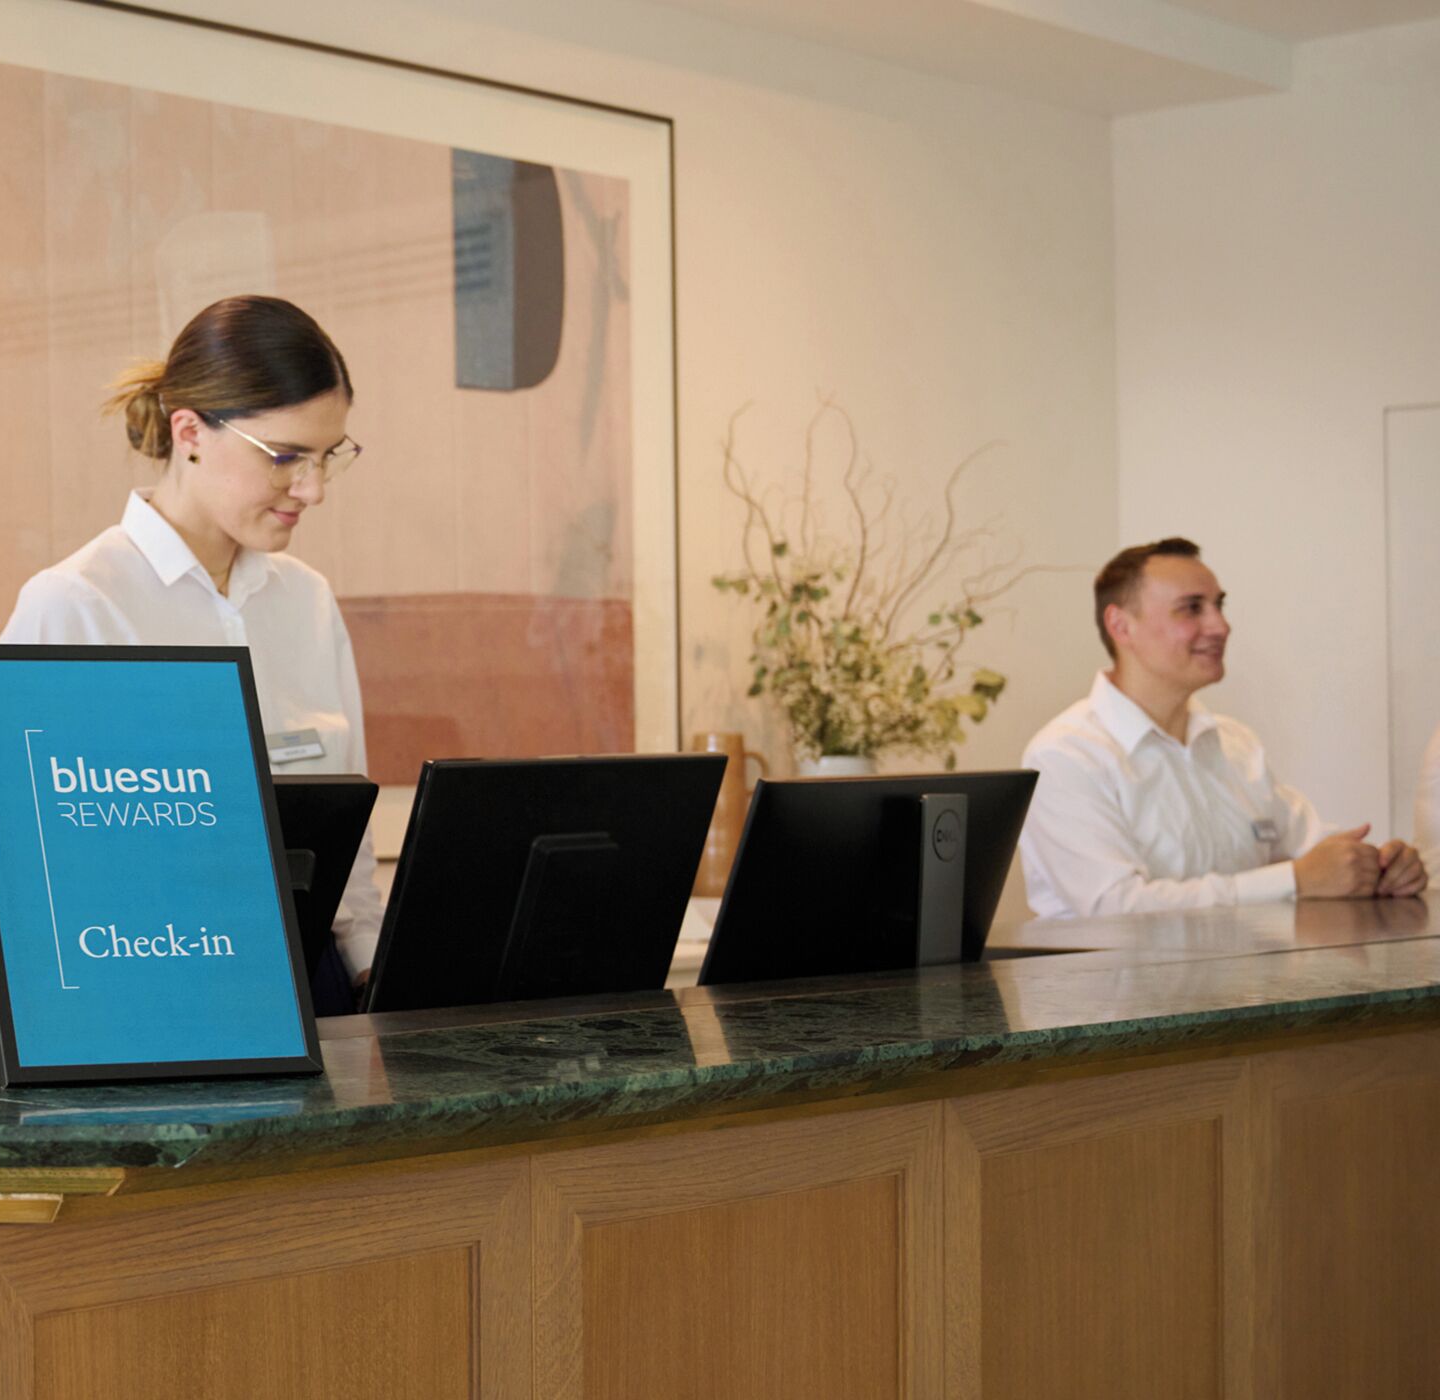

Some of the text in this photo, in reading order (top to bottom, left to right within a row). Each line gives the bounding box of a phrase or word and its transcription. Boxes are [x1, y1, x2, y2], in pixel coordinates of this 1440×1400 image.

[50, 756, 212, 793] bluesun
[57, 801, 217, 827] REWARDS
[79, 924, 235, 959] Check-in
